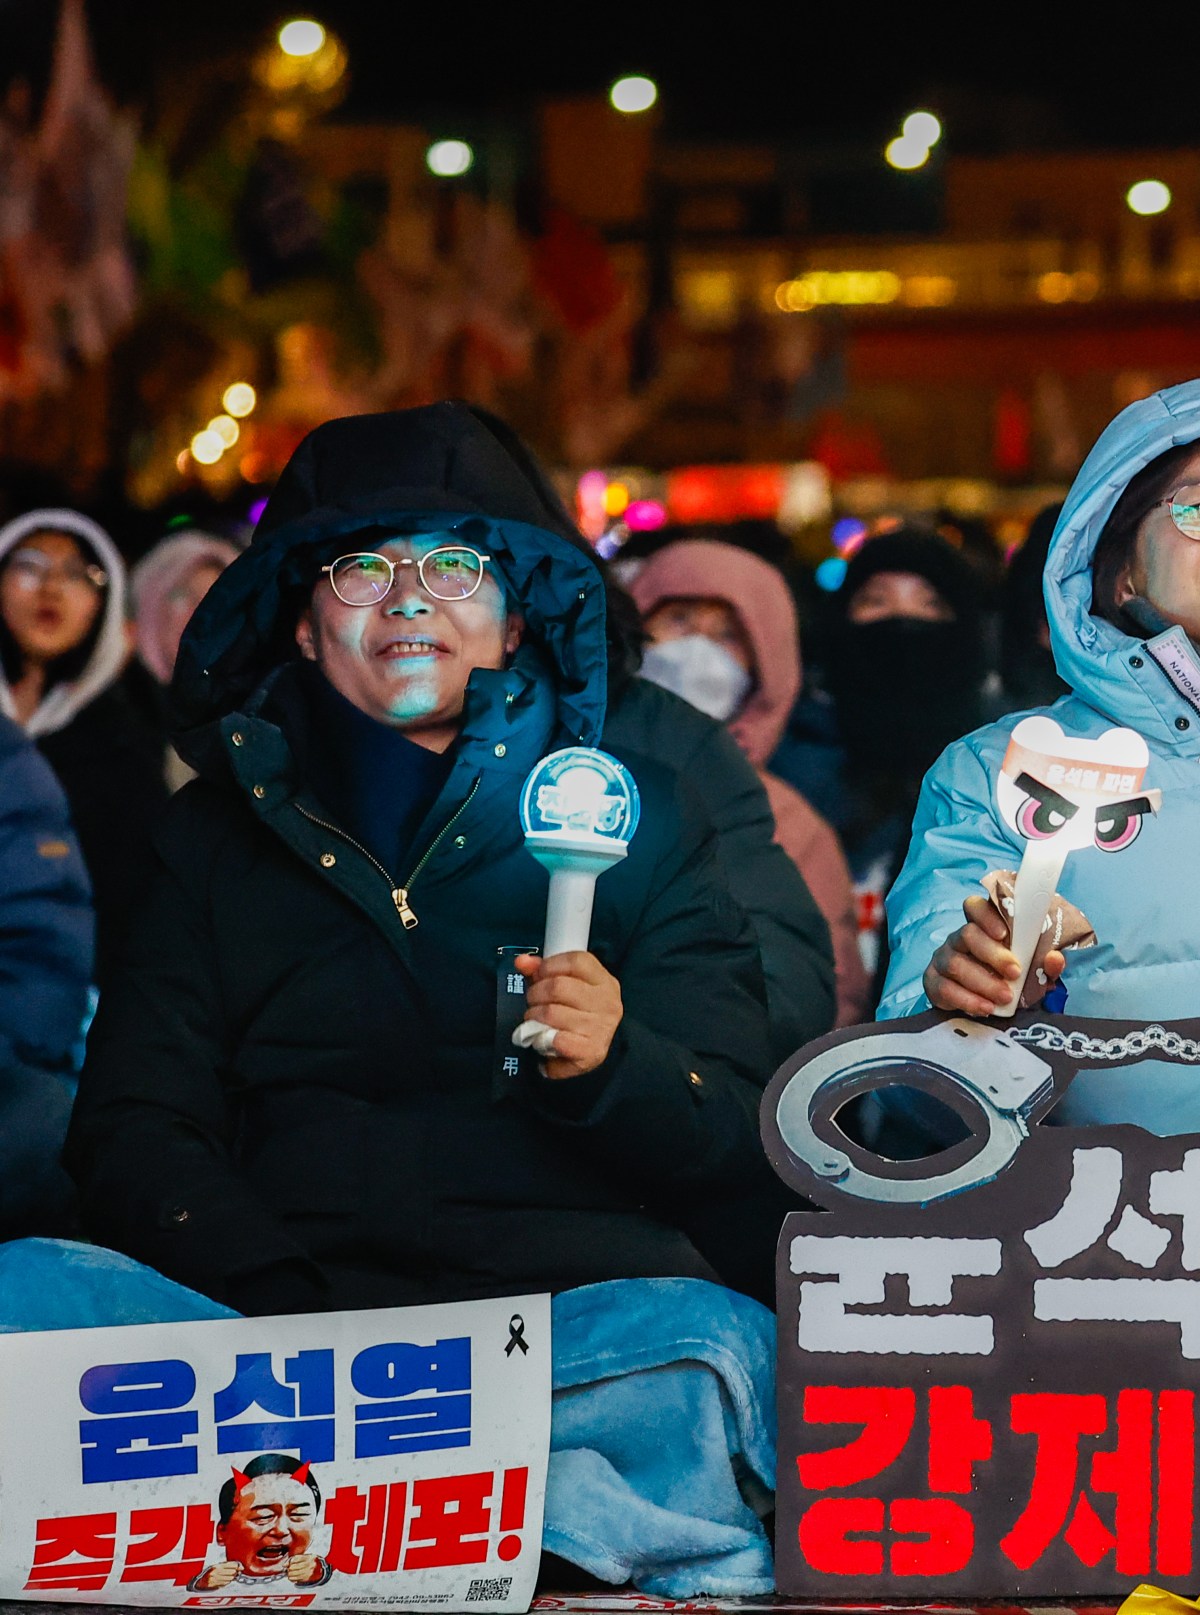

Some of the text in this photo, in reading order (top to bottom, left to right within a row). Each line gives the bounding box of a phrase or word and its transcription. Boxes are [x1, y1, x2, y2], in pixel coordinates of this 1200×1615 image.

[79, 1336, 472, 1485] 윤석열
[22, 1466, 529, 1591] 즉각 체포!
